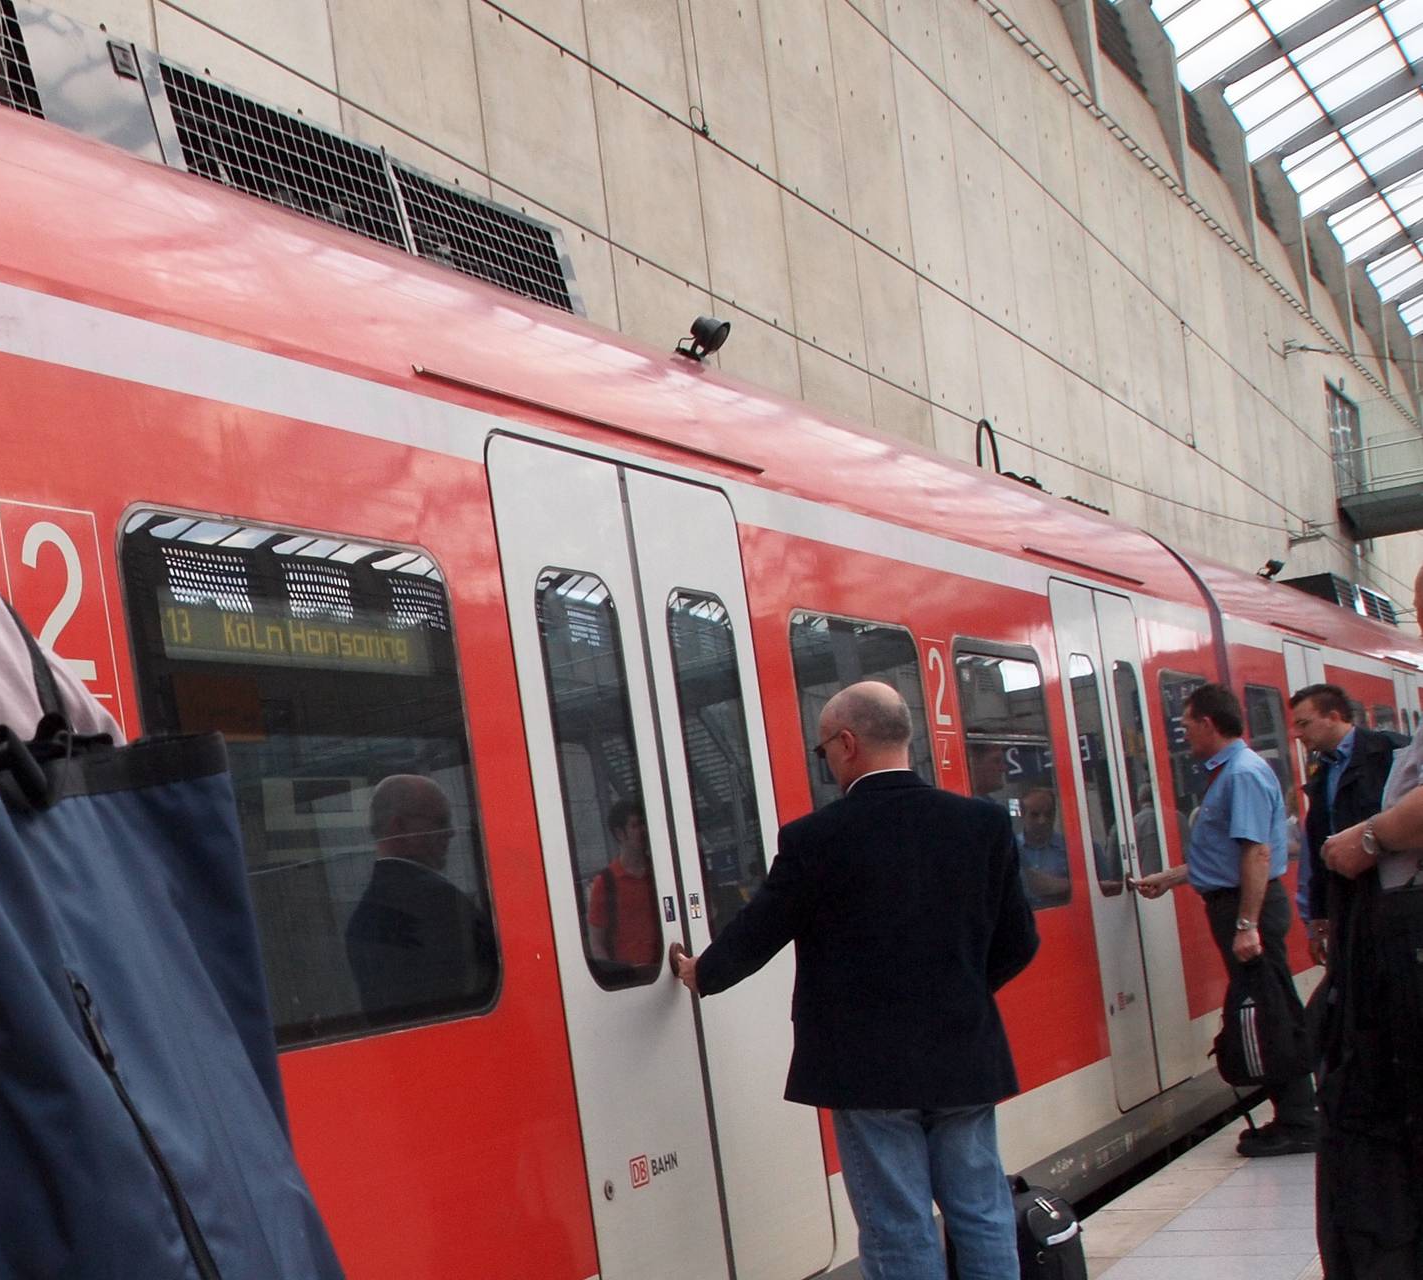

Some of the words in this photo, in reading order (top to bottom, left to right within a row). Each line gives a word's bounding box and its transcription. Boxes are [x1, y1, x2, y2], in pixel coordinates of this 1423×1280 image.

[21, 521, 98, 681] 2
[288, 619, 409, 665] Hansaring
[928, 647, 952, 726] 2
[631, 1159, 648, 1185] DB
[651, 1151, 678, 1176] BAHN
